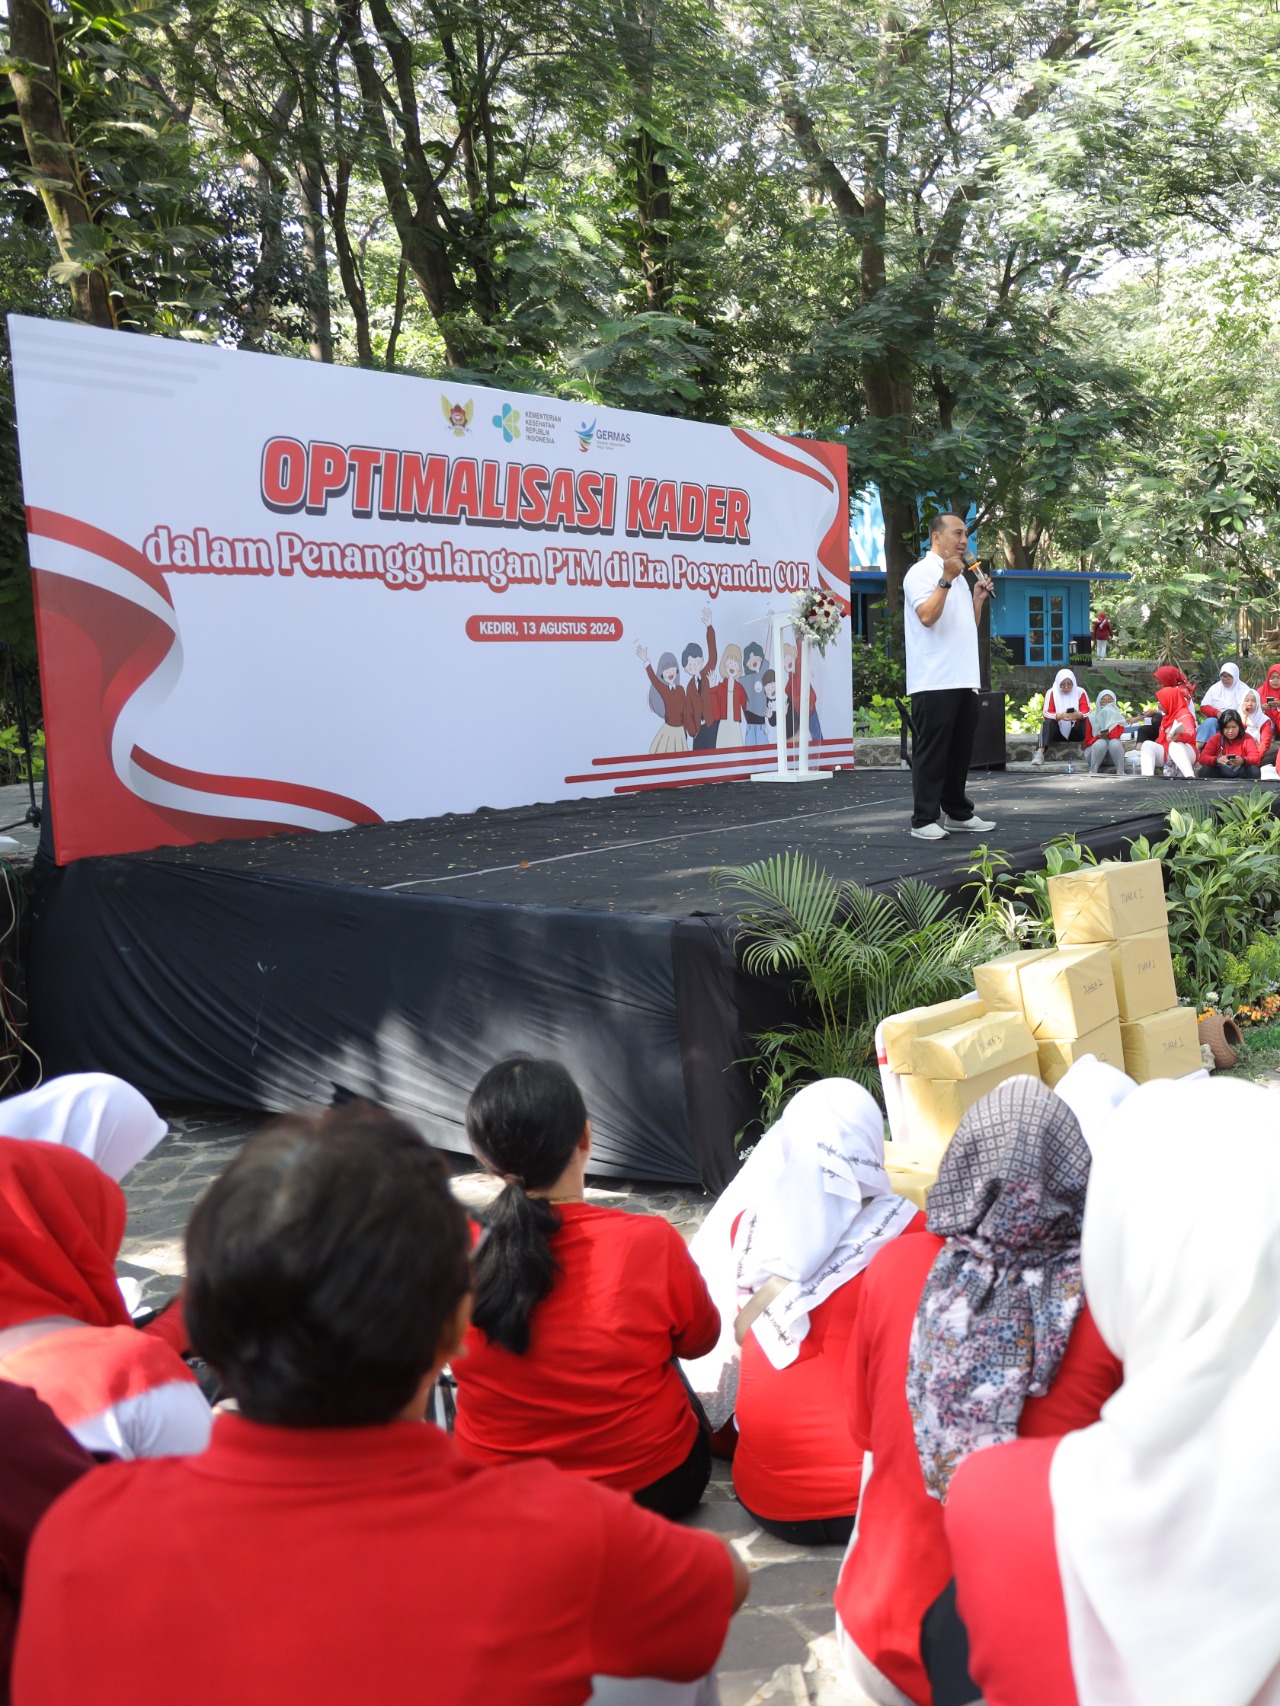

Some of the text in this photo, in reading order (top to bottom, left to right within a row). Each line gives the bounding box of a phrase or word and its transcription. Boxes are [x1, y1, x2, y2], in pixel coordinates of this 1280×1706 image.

[525, 411, 562, 422] KEMENTERIAN
[525, 420, 555, 429] KESEHATAN
[525, 427, 551, 436] REPUBLIK
[596, 429, 631, 443] GERMAS
[525, 435, 555, 444] INDONESIA
[261, 436, 751, 544] OPTIMALISASI KADER
[144, 526, 810, 597] dalam Penanggulangan PTM di Era Posyandu COE
[479, 621, 616, 637] KEDIRI, 13 AGUSTUS 2024
